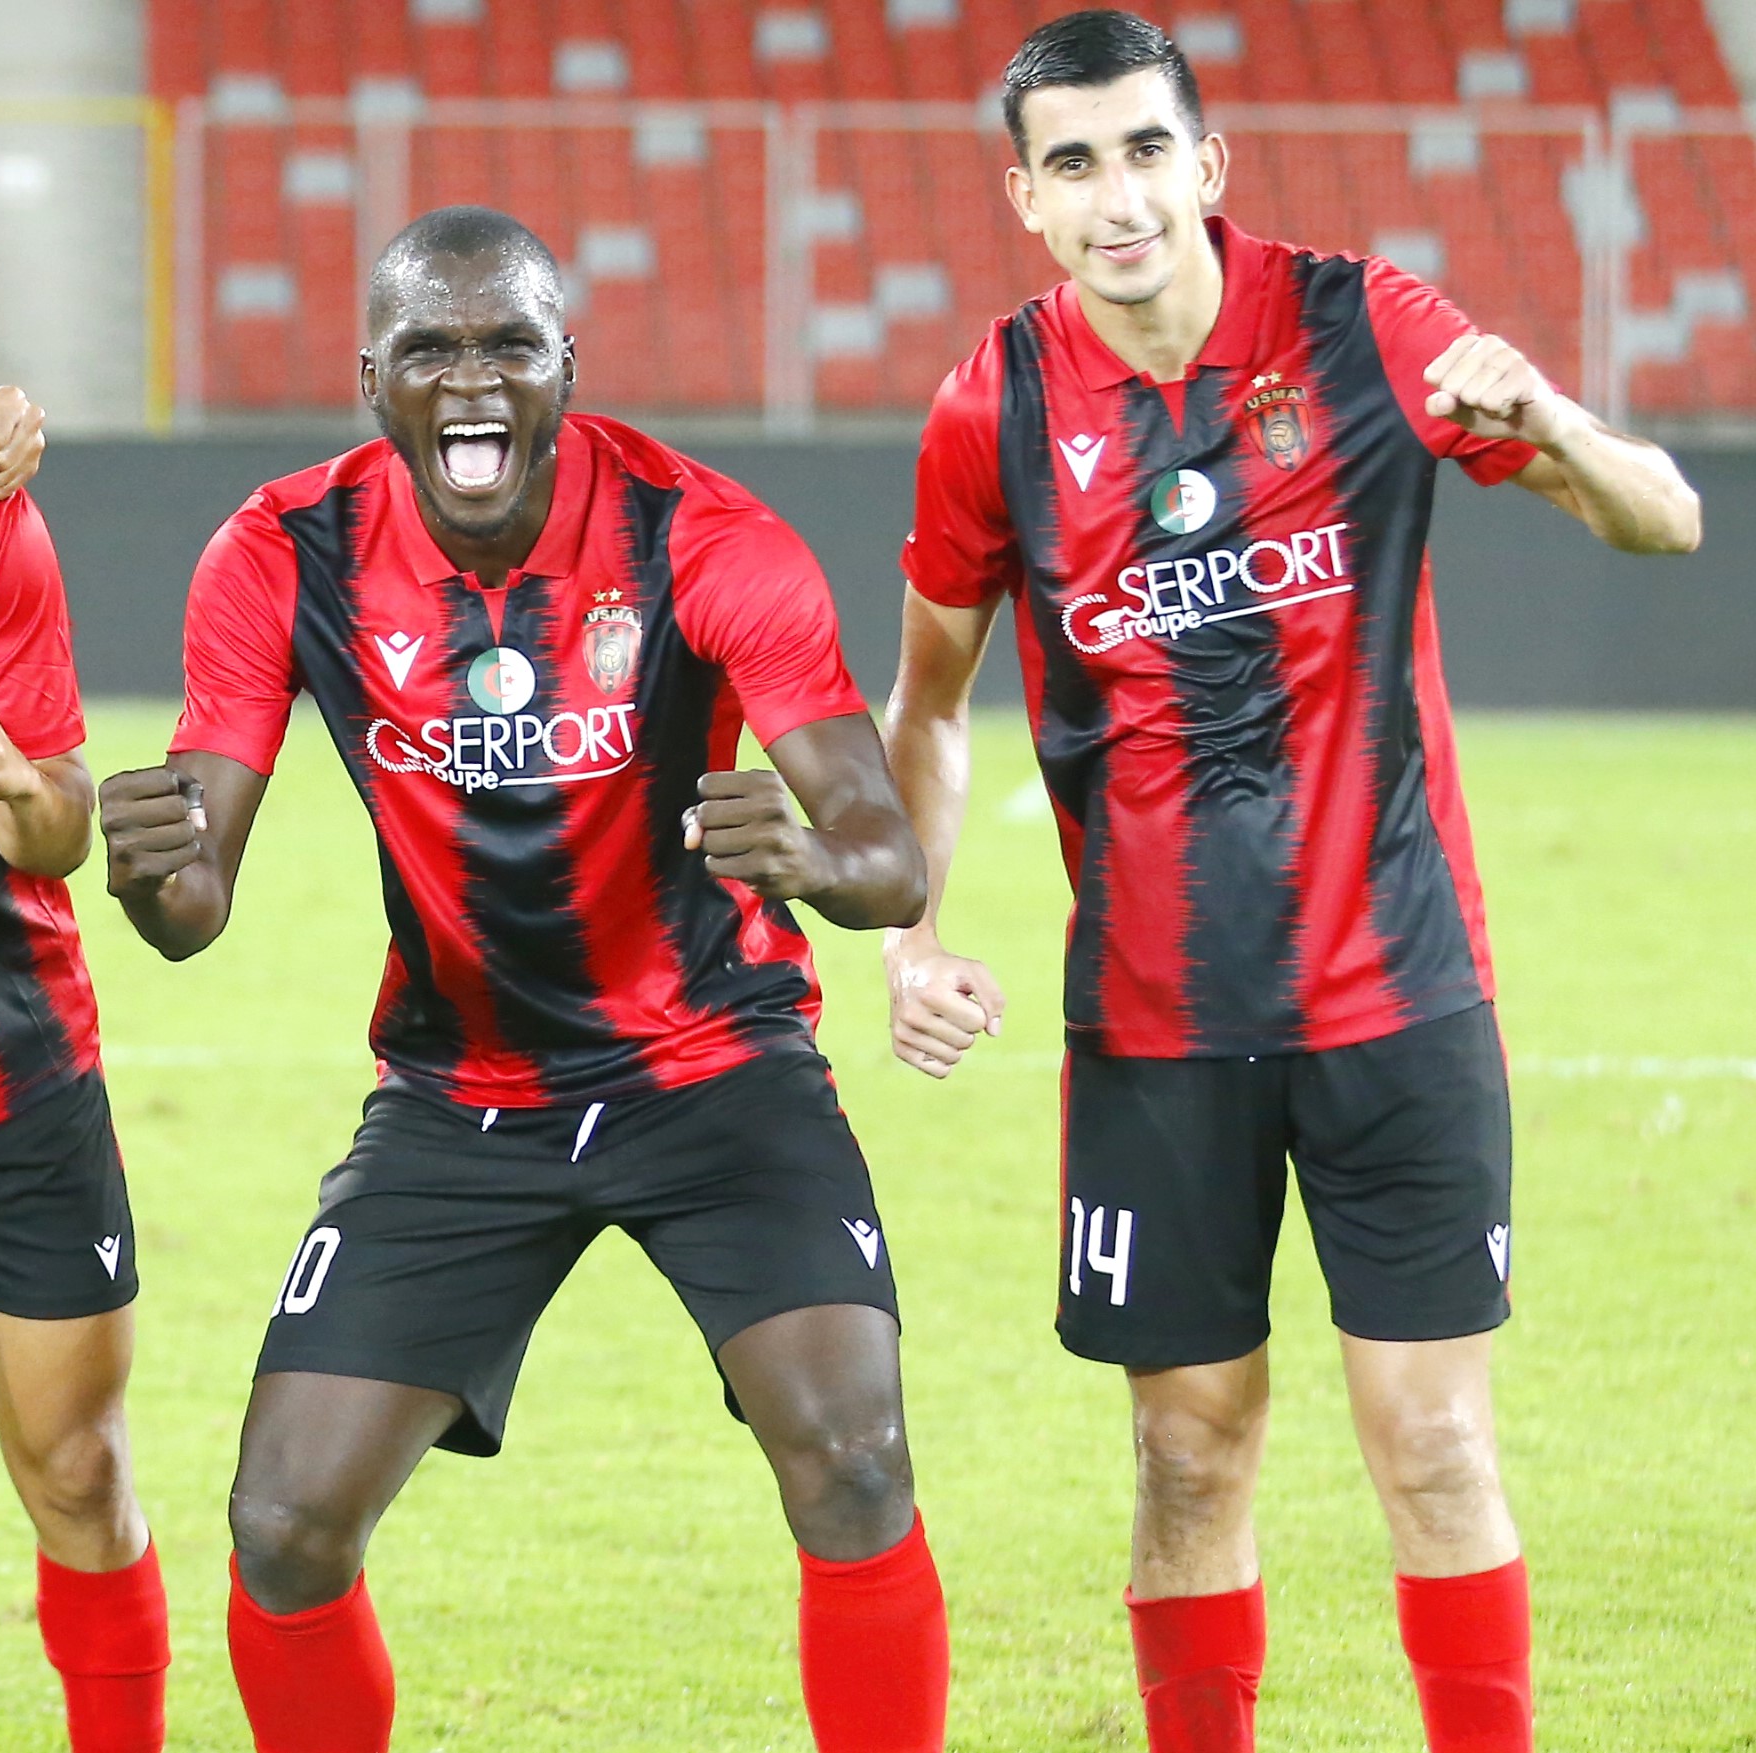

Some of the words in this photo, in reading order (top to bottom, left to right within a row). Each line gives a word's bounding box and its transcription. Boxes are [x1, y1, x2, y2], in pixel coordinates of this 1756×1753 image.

[1246, 388, 1299, 409] USMA
[1117, 522, 1348, 618] SERPORT
[587, 608, 635, 624] USMA
[421, 703, 636, 770] SERPORT
[1069, 1195, 1134, 1306] 14
